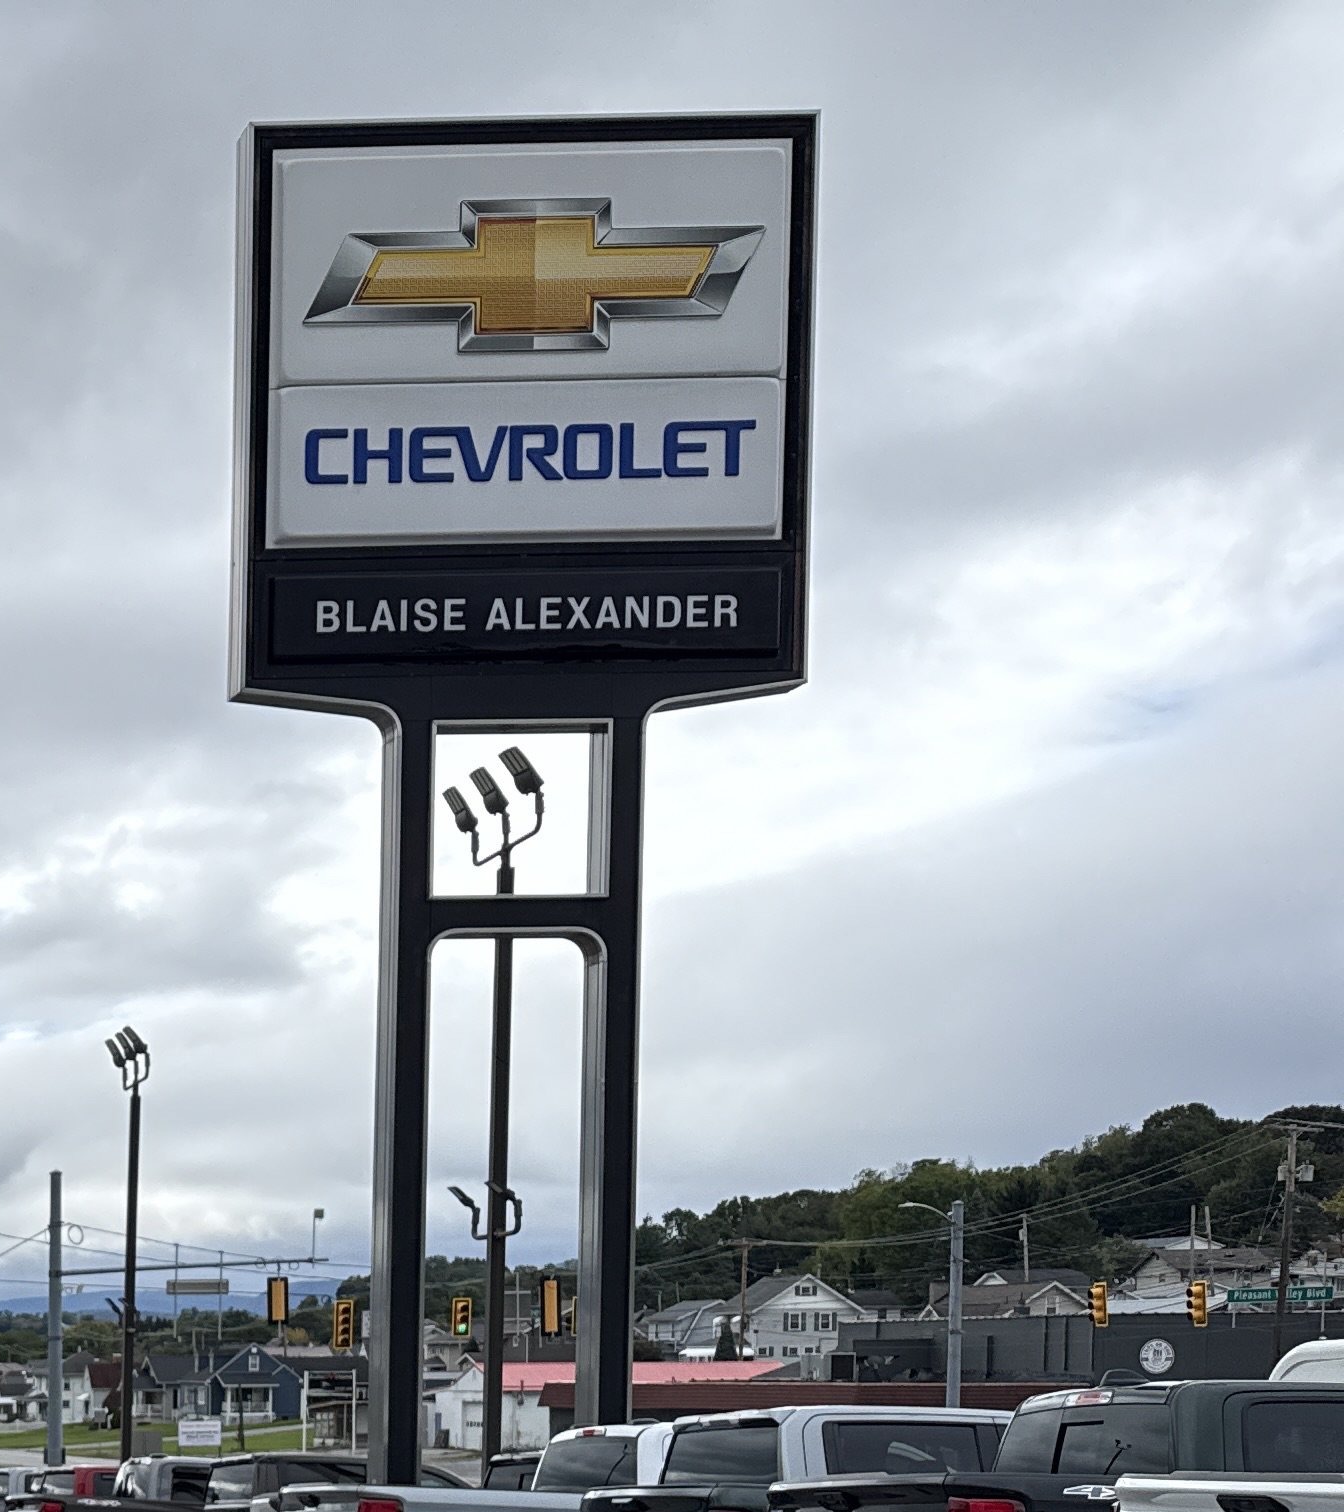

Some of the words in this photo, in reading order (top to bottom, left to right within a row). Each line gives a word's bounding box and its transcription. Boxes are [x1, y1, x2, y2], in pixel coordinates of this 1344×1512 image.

[304, 419, 757, 485] CHEVROLET
[315, 597, 467, 634] BLAISE
[484, 594, 739, 631] ALEXANDER
[1234, 1289, 1272, 1300] Pleasant
[1275, 1287, 1303, 1301] lley
[1306, 1288, 1327, 1299] Blvd
